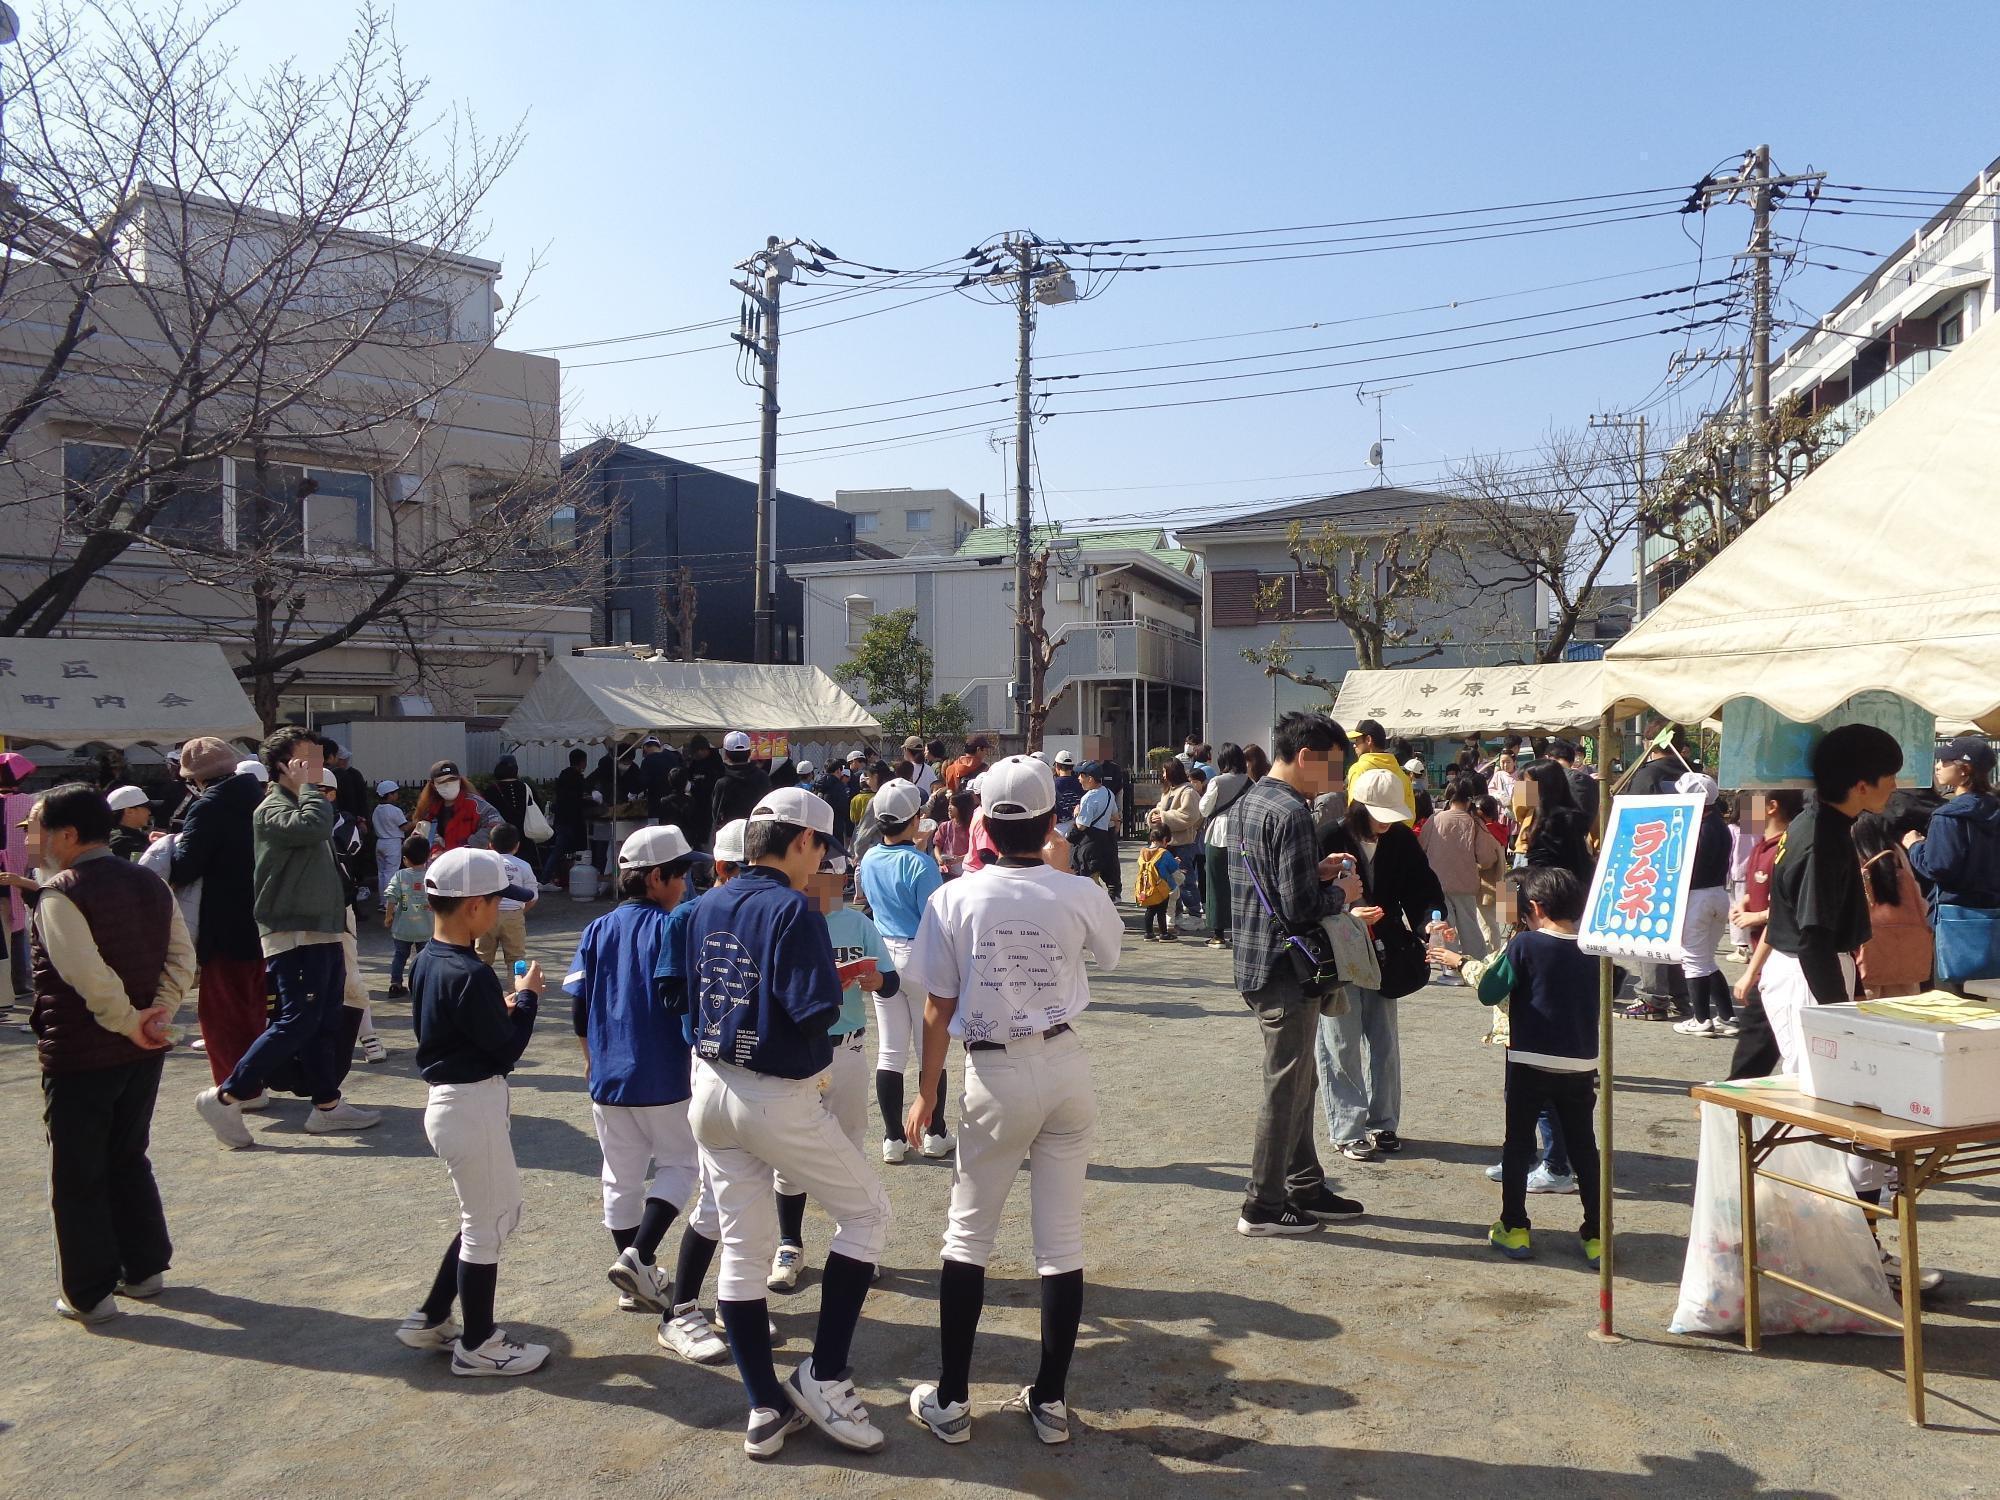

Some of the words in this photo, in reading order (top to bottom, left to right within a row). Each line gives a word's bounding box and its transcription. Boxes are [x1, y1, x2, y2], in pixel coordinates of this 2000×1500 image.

[1420, 681, 1531, 698] 中原区
[21, 692, 194, 709] 町内会
[1367, 699, 1579, 718] 西加瀬町内会
[1615, 820, 1668, 920] ラムネ
